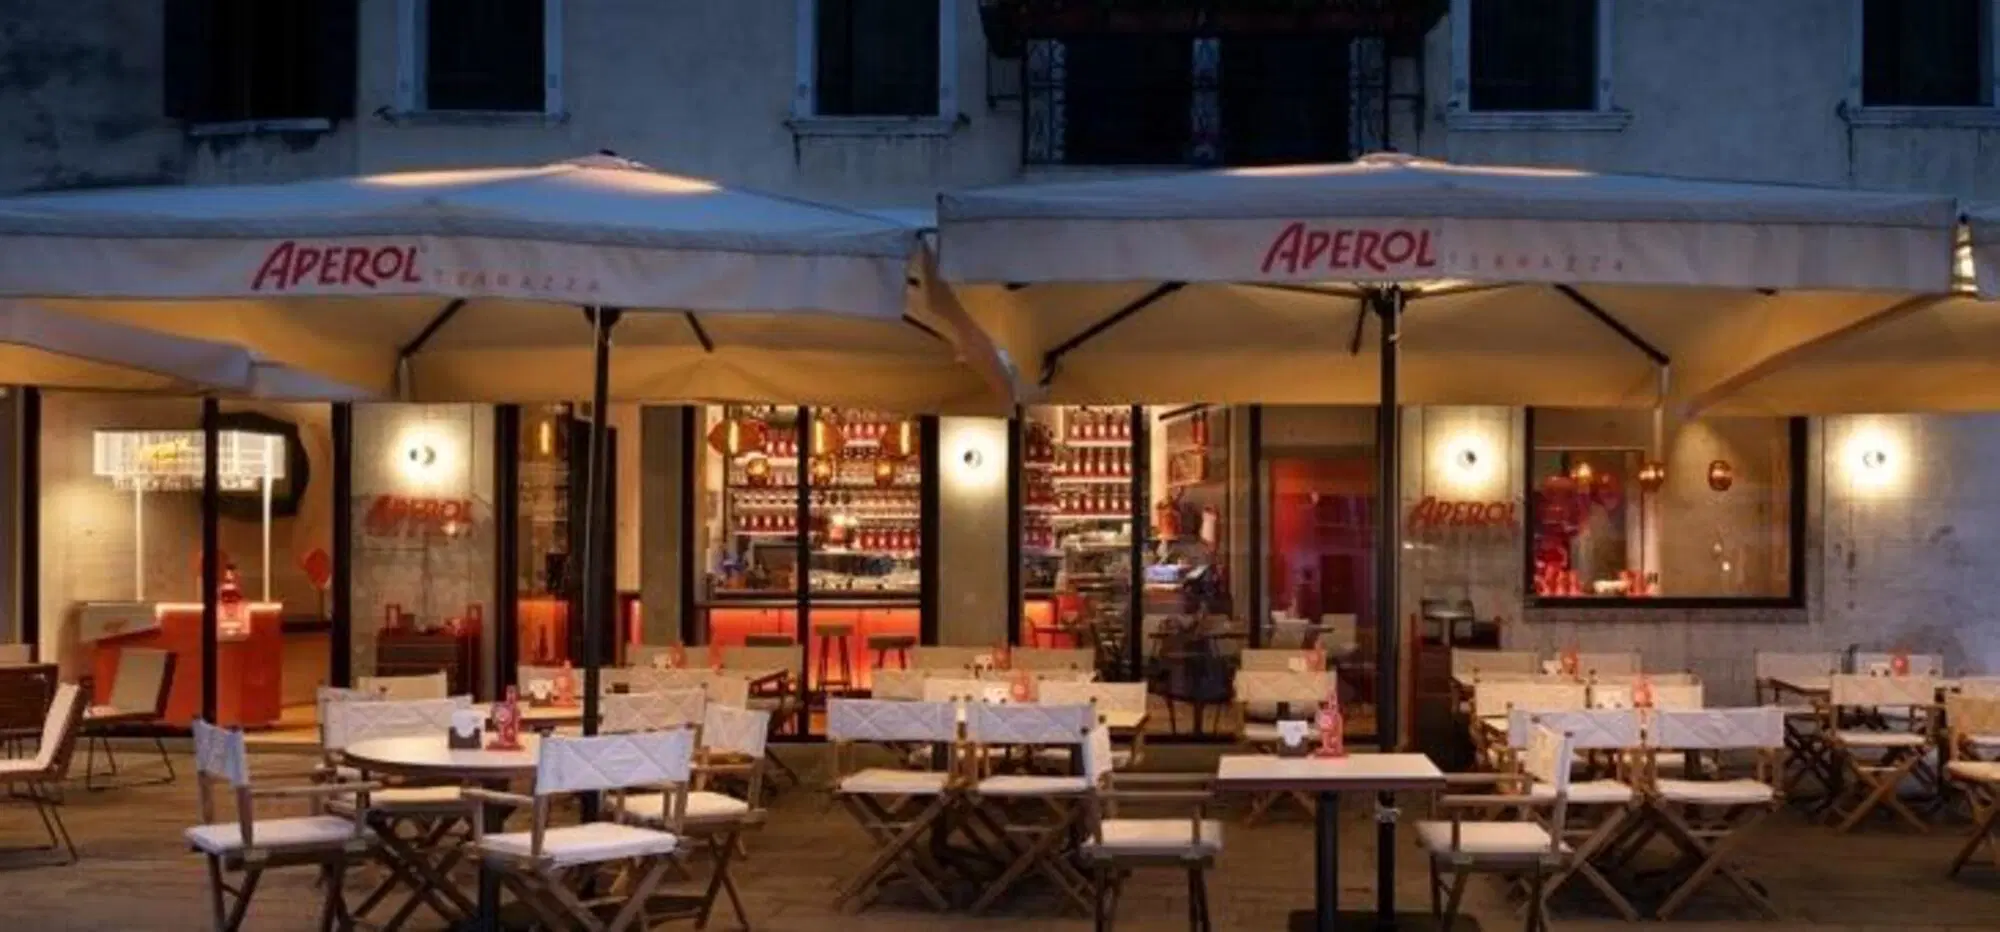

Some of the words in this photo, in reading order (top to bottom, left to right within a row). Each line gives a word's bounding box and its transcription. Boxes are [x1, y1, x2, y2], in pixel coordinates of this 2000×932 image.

[251, 240, 421, 291] APEROL
[1261, 221, 1437, 273] APEROL
[365, 494, 473, 536] APEROL
[1407, 495, 1515, 535] APEROL
